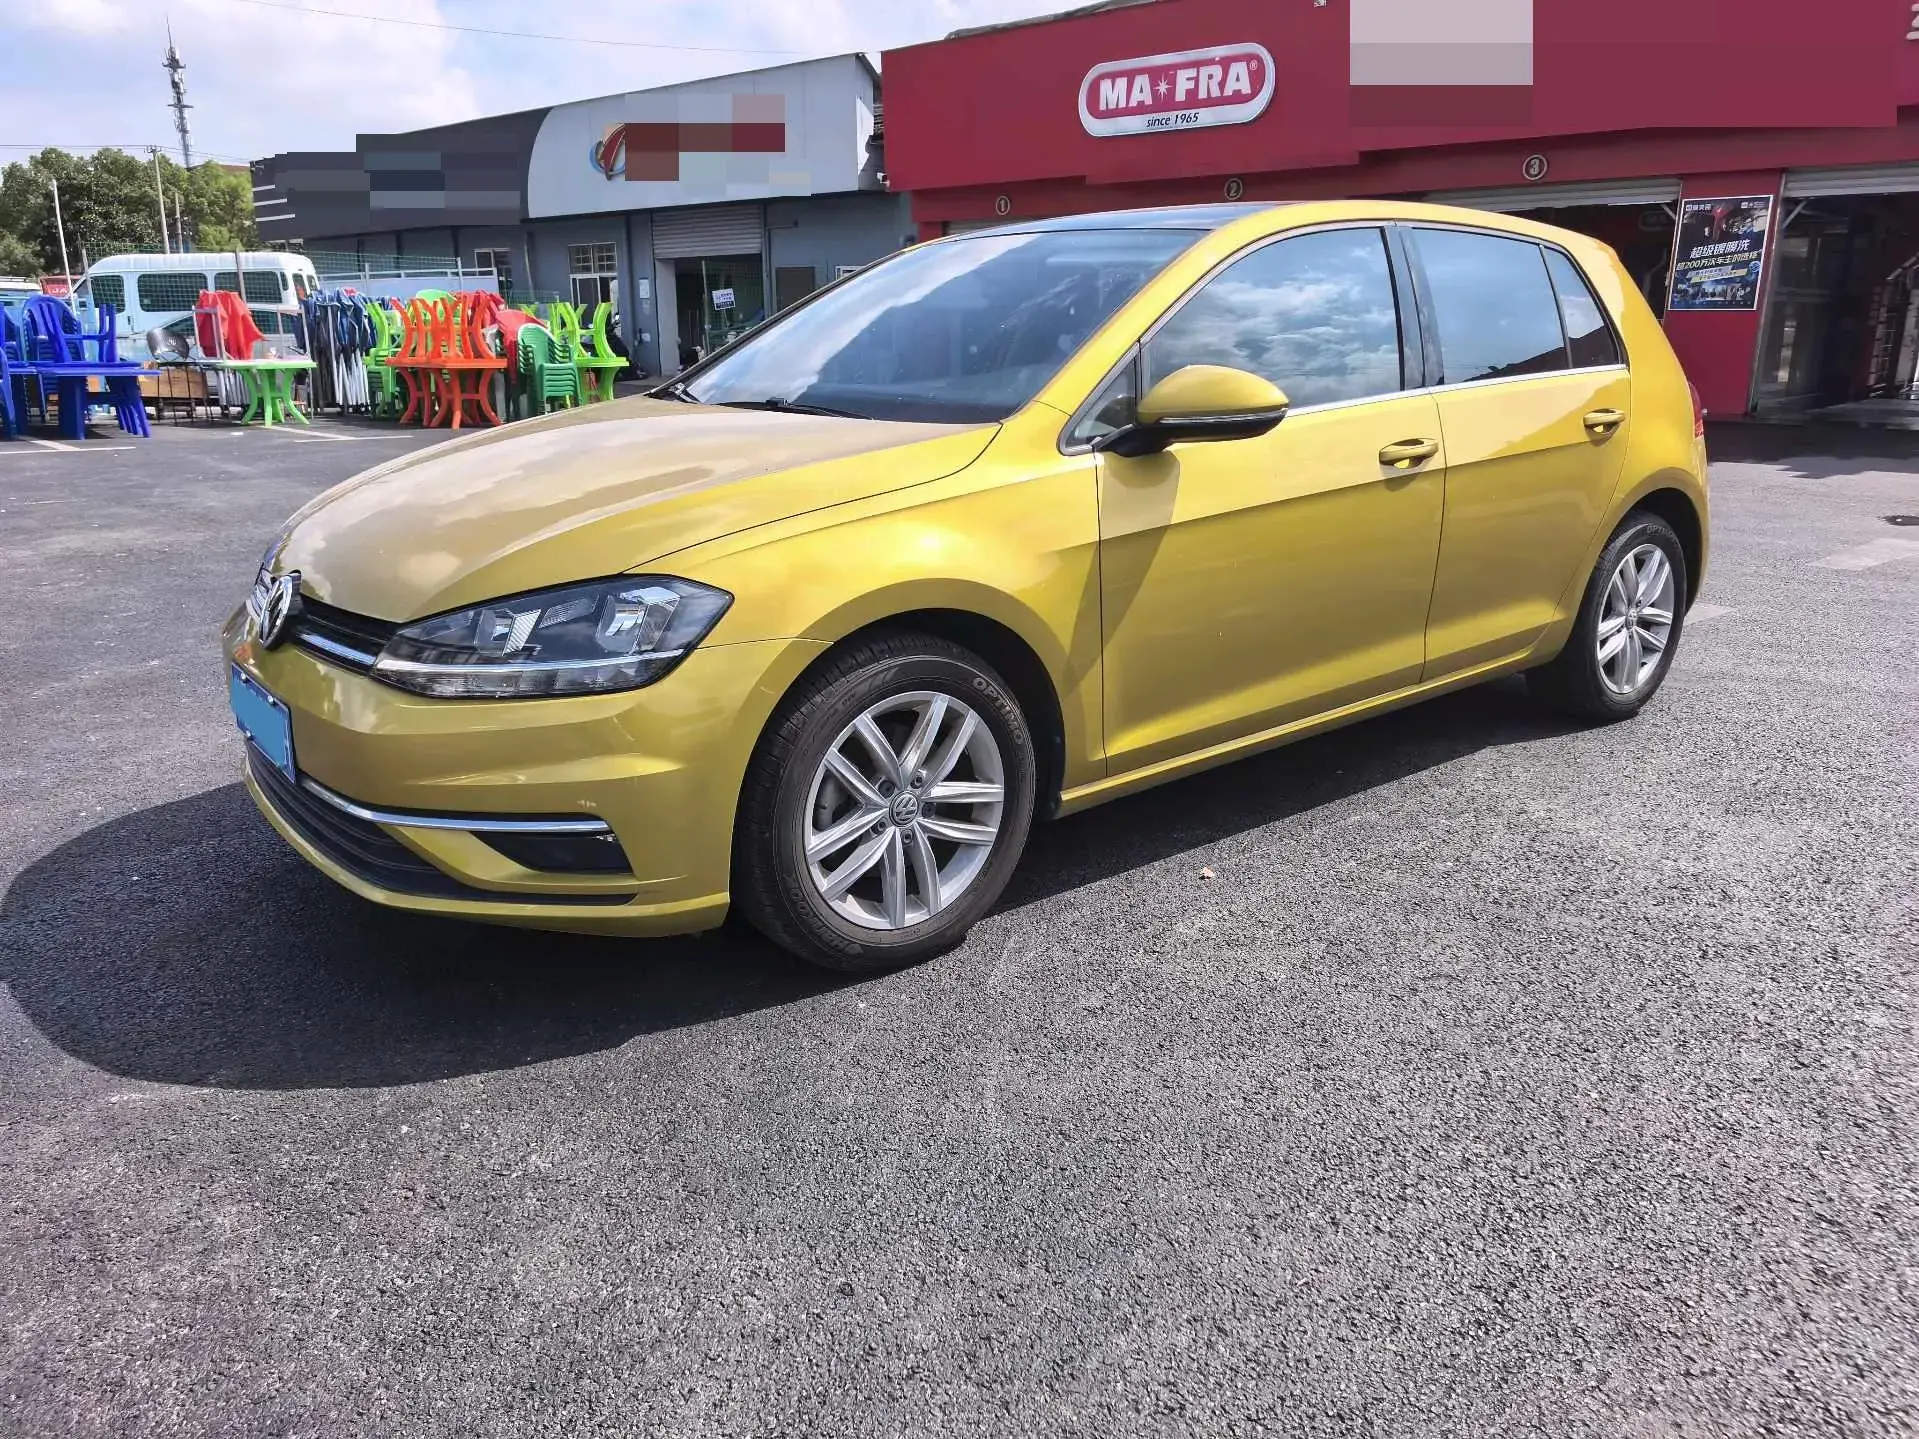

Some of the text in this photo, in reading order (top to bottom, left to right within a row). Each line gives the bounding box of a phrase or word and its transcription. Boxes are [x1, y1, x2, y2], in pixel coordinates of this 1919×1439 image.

[1146, 112, 1200, 128] since 1965
[1690, 240, 1751, 259] 超级镀膜洗
